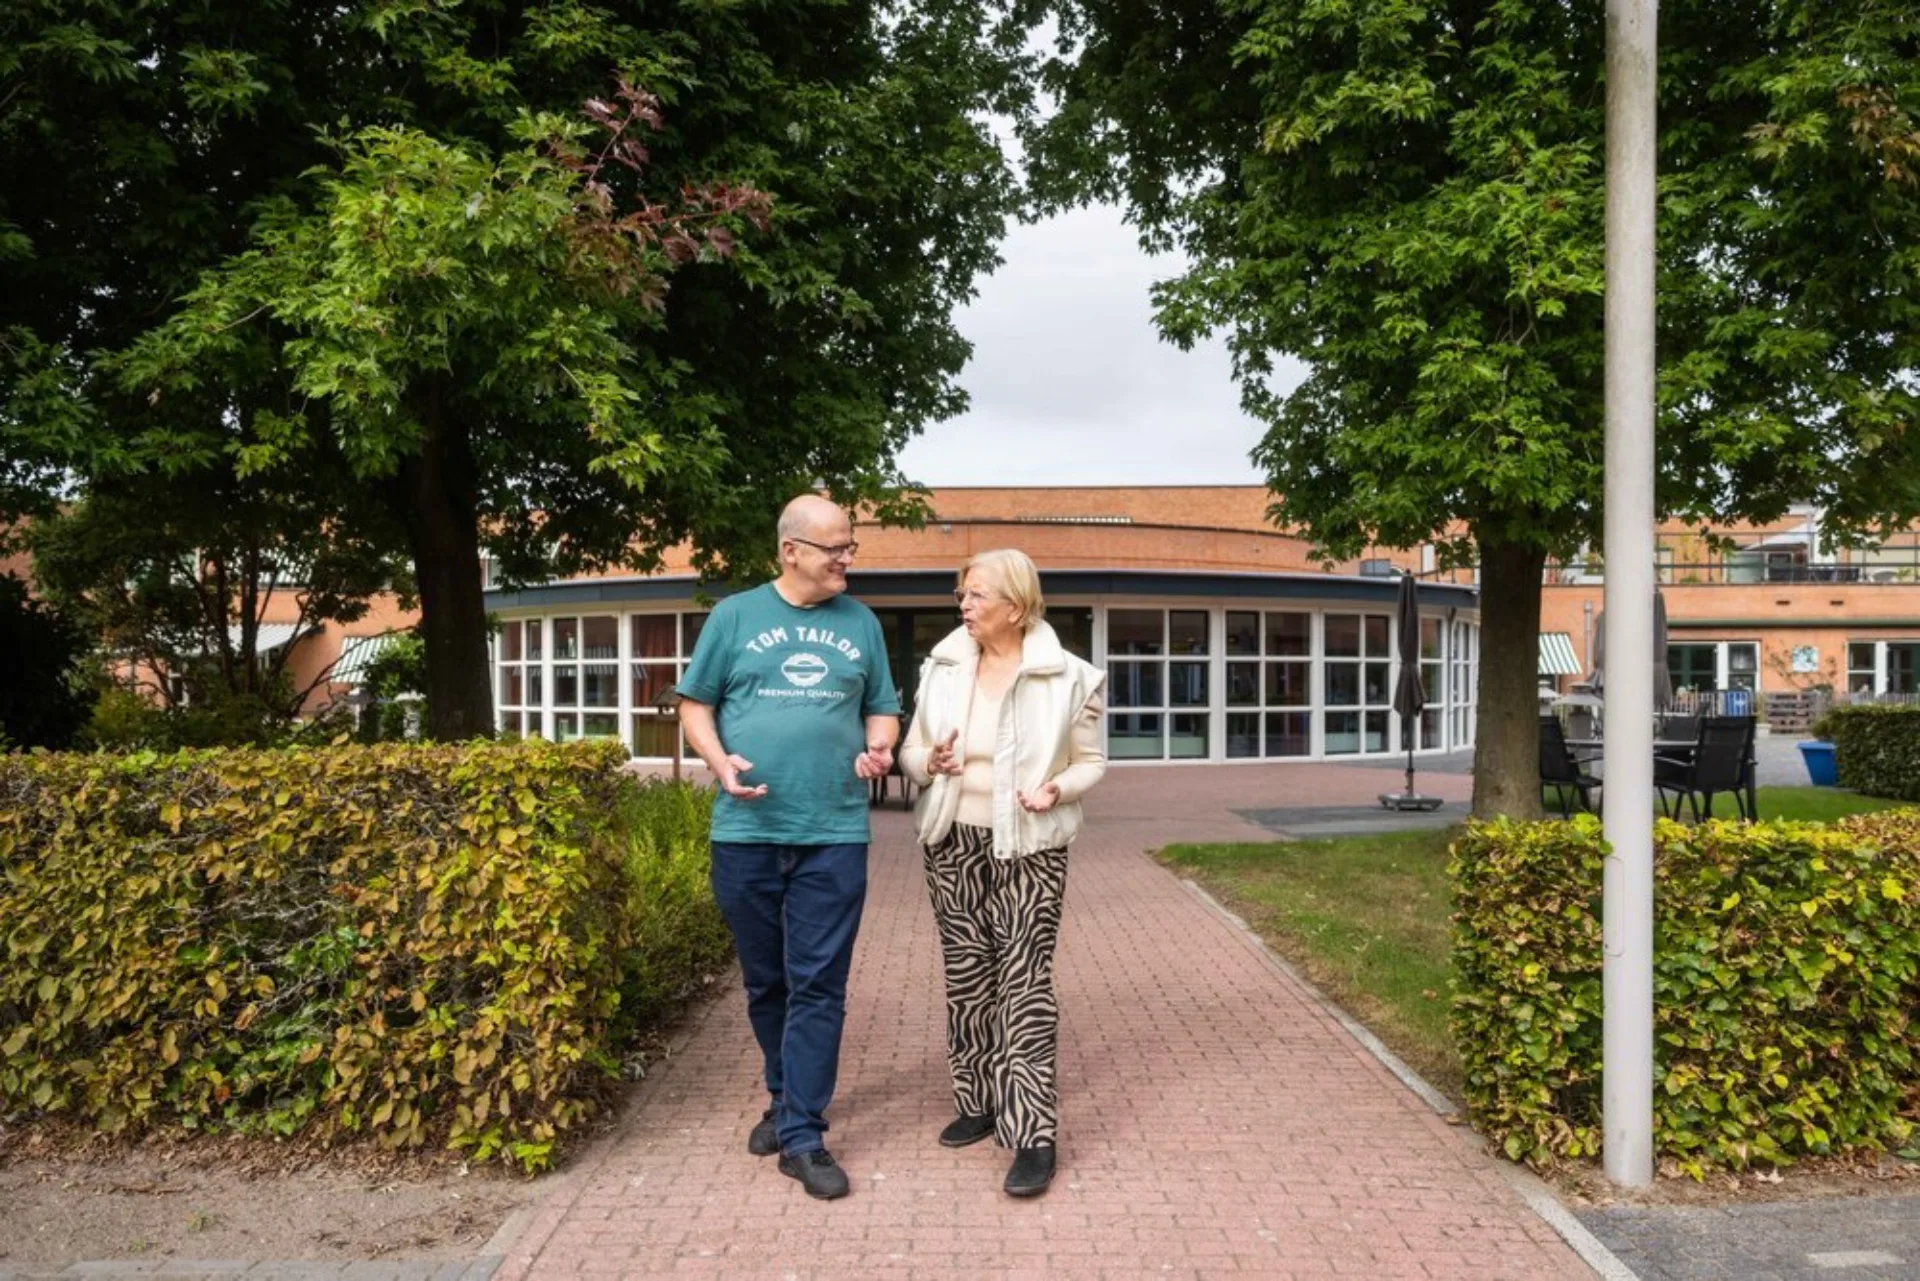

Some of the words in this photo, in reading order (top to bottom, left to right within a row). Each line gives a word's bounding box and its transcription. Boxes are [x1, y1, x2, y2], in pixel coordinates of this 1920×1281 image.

[746, 627, 788, 654] TOM
[796, 627, 861, 661] TAILOR
[758, 688, 805, 697] PREMIUM
[807, 689, 846, 699] QUALITY
